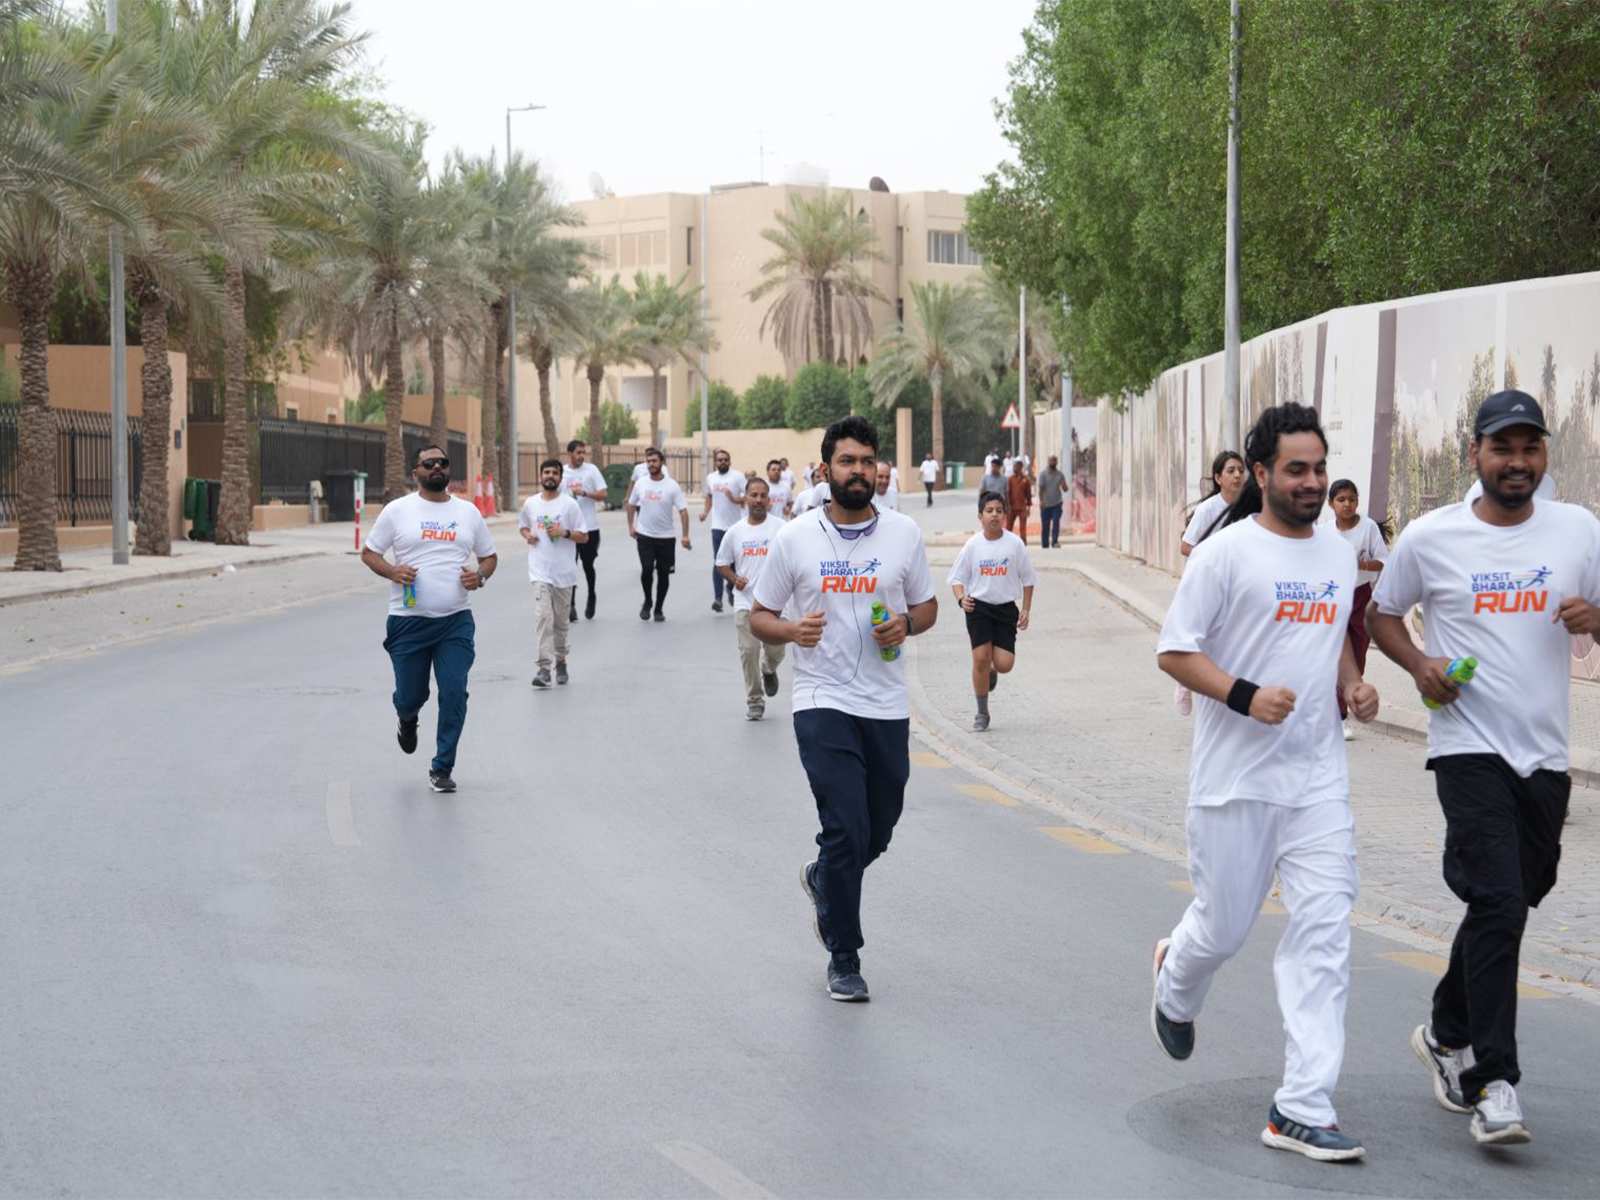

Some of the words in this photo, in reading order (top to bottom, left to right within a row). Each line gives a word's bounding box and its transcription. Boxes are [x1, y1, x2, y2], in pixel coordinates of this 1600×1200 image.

[421, 530, 457, 541] RUN
[743, 547, 768, 556] RUN
[820, 568, 859, 576] BHARAT
[980, 567, 1008, 577] RUN
[1471, 572, 1511, 582] VIKSIT
[821, 576, 878, 593] RUN
[1275, 582, 1307, 591] VIKSIT
[1472, 580, 1523, 592] BHARAT
[1276, 591, 1317, 601] BHARAT
[1473, 590, 1548, 614] RUN
[1275, 601, 1337, 625] RUN
